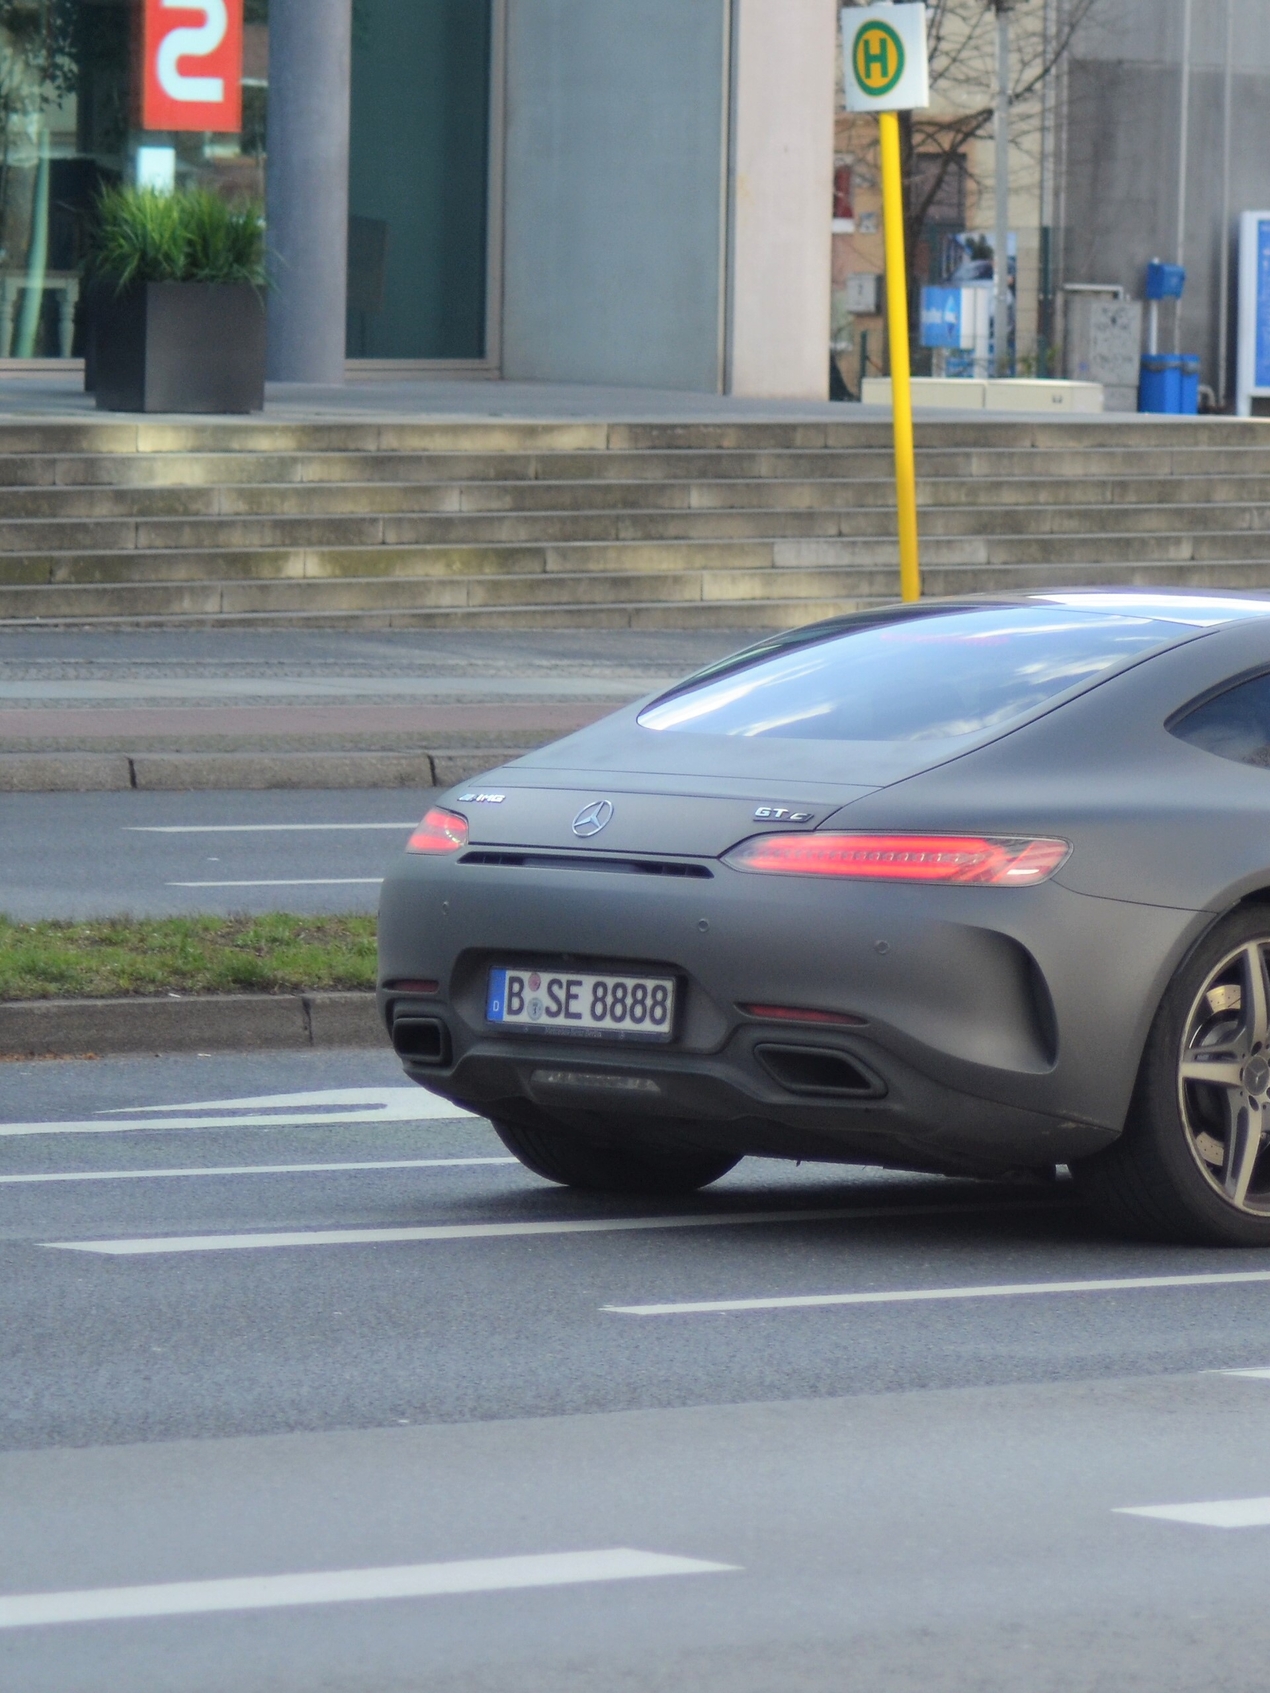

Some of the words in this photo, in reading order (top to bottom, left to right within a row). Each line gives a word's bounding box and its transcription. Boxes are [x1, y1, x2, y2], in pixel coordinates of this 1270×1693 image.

[863, 37, 888, 79] H
[754, 806, 789, 818] GT
[492, 1000, 500, 1012] D
[506, 975, 525, 1016] B
[545, 978, 583, 1020] SE
[590, 980, 669, 1026] 8888
